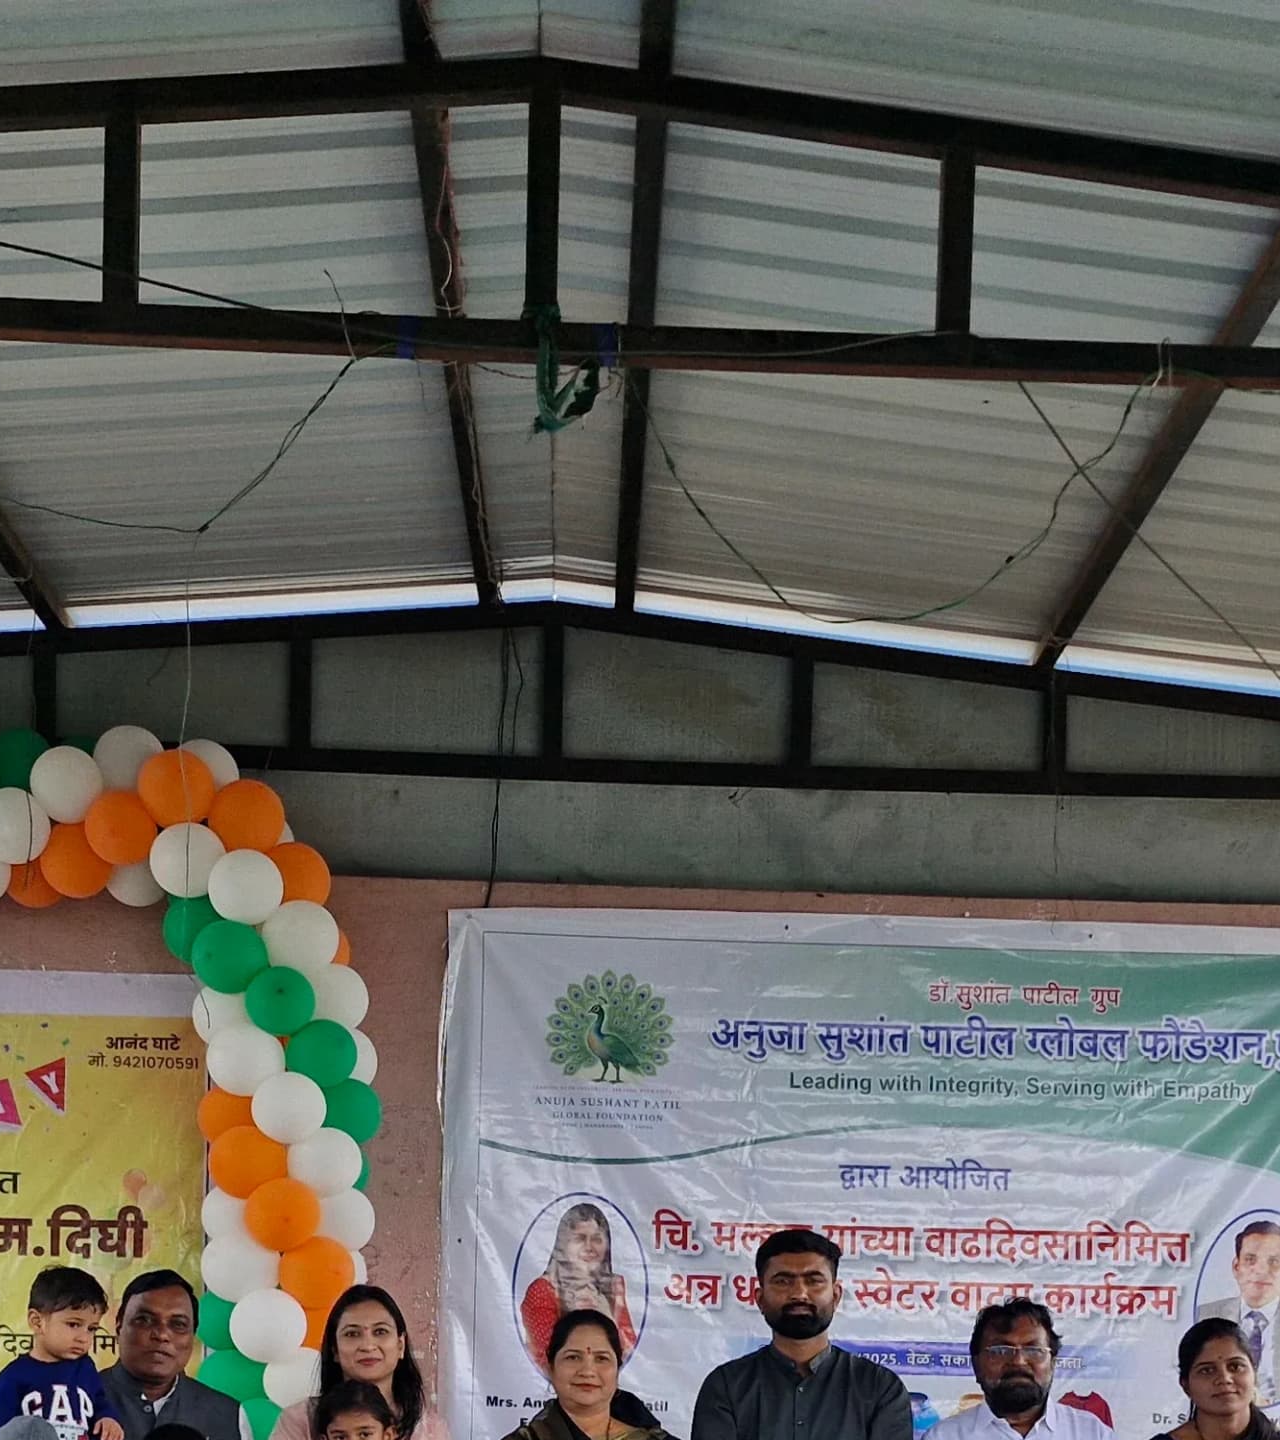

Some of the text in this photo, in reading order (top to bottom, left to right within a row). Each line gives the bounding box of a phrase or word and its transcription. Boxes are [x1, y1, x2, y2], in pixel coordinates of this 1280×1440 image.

[1023, 981, 1080, 1005] पाटील
[105, 1033, 181, 1051] आनंद घाटे
[710, 1018, 808, 1060] अनुजा
[816, 1015, 912, 1062] सुशांत
[920, 1014, 1018, 1057] पाटील
[1025, 1016, 1130, 1061] ग्लोबल
[112, 1054, 200, 1070] 9421070591
[789, 1071, 1256, 1104] Leading with Integrity, Serving with Empathy
[535, 1096, 682, 1110] ANUJA SUSHANT PATIL
[552, 1111, 664, 1122] GLOBAL FOUNDATION
[838, 1158, 1012, 1191] द्वारा आयोजित
[651, 1208, 700, 1252] चि.
[923, 1217, 1191, 1264] वाढदिवसानिमित्त
[852, 1266, 940, 1311] स्वेटर
[1043, 1272, 1178, 1316] कार्यक्रम
[486, 1395, 518, 1408] Mrs.
[645, 1400, 669, 1412] atil
[1152, 1412, 1173, 1425] Dr.
